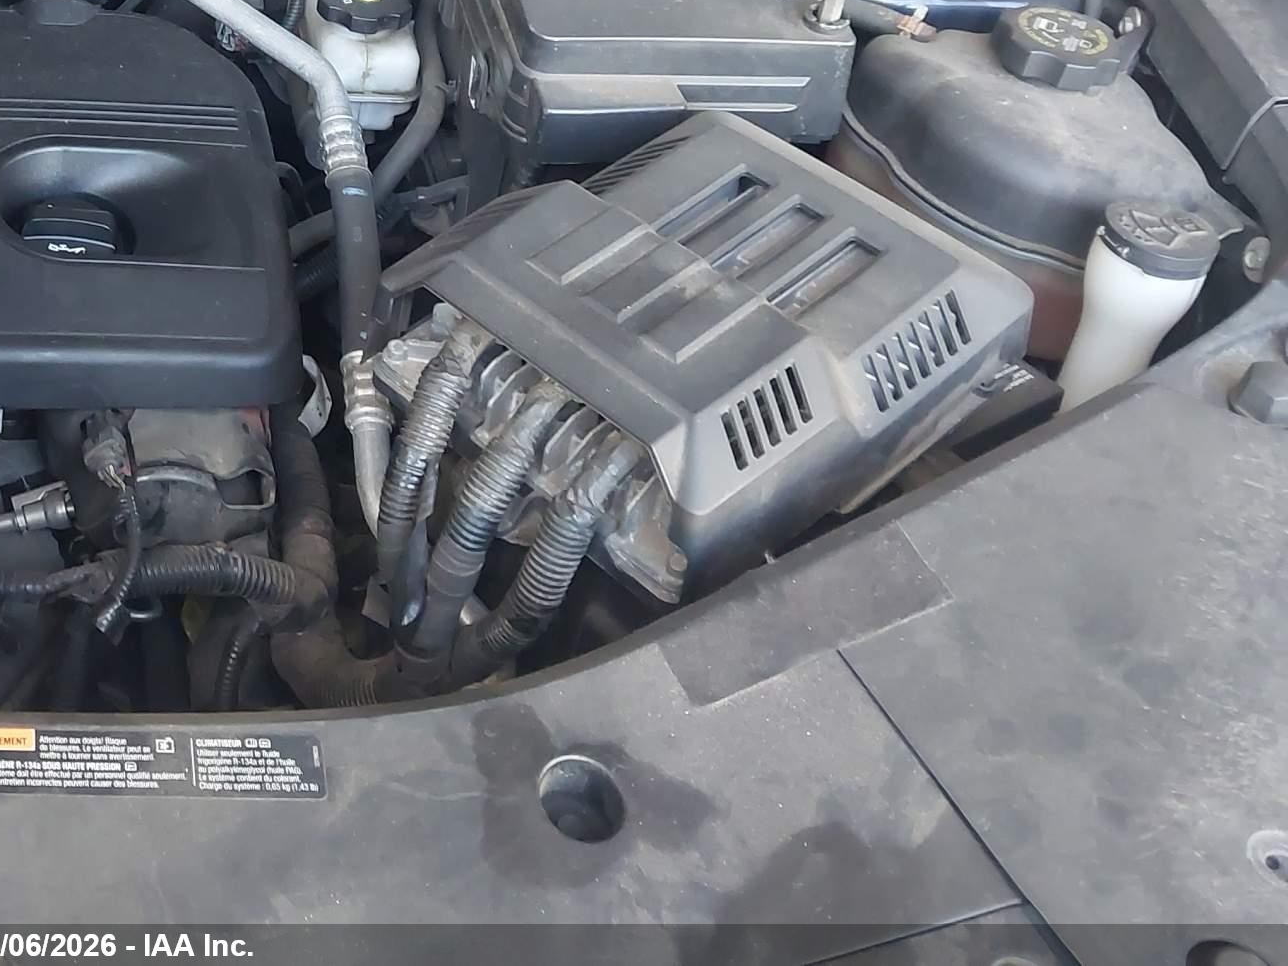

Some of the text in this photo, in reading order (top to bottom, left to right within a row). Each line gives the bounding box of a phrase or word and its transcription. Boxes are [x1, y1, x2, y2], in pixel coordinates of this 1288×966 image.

[39, 735, 68, 744] Attention
[195, 738, 241, 748] CLIMATISEUR
[15, 760, 41, 770] R-134a
[42, 761, 61, 770] SOUS
[62, 762, 85, 771] HAUTE
[86, 762, 121, 772] PRESSION
